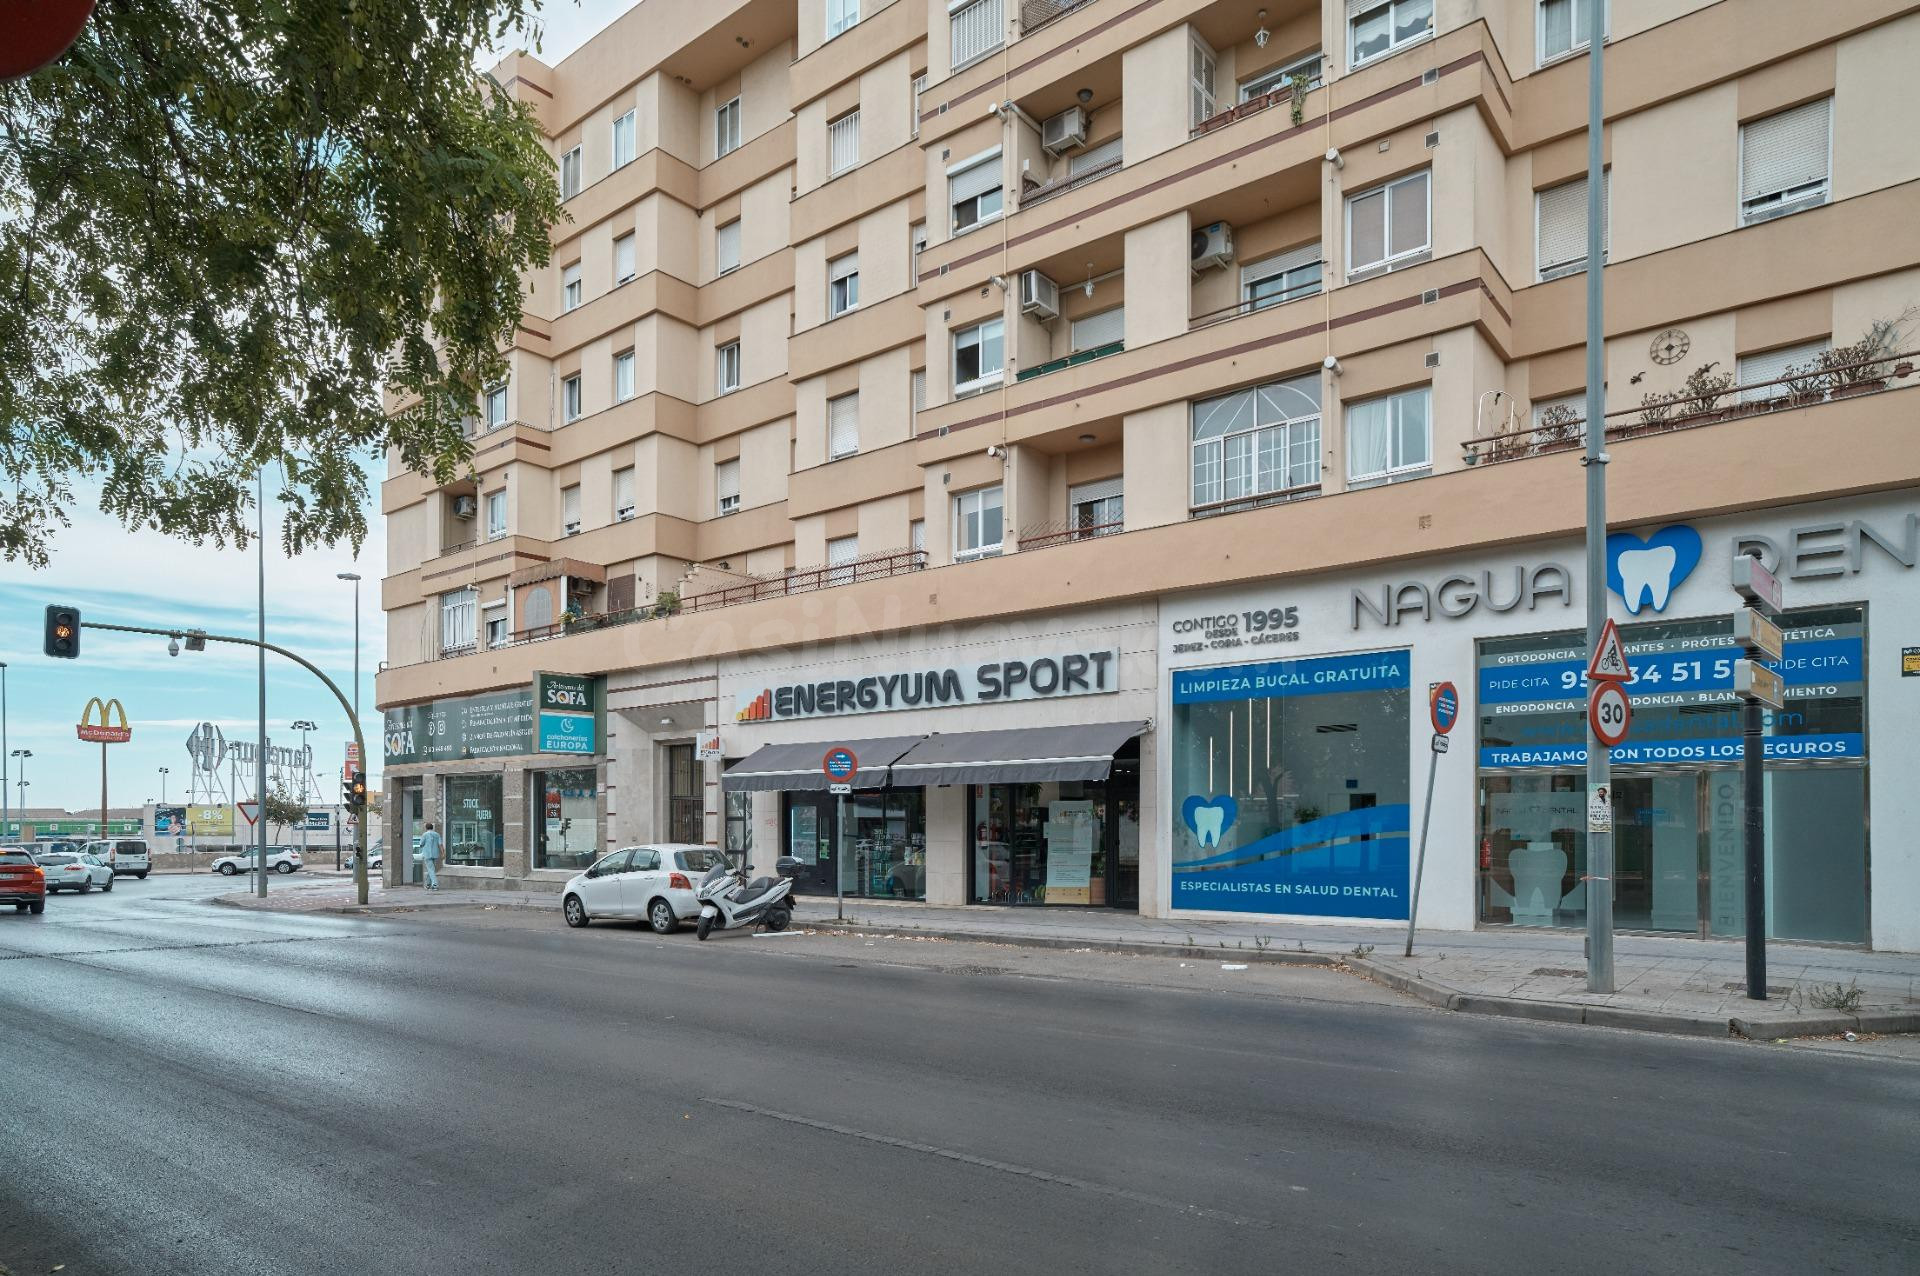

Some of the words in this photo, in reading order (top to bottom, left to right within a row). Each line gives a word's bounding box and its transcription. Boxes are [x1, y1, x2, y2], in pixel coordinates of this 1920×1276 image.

[1350, 562, 1571, 630] NAGUA
[1172, 613, 1239, 634] CONTIGO
[1242, 605, 1299, 633] 1995
[1172, 641, 1204, 654] JEREZ
[1210, 638, 1243, 649] CORIA
[1250, 631, 1300, 645] CÁCERES
[1204, 627, 1238, 640] DESDE
[1498, 651, 1576, 664] ORTODONCIA
[1623, 642, 1664, 653] ANTES
[1682, 636, 1735, 649] PRÓTES
[1783, 627, 1836, 641] TÉTICA
[774, 668, 966, 717] ENERGYUM
[976, 650, 1112, 701] SPORT
[1180, 678, 1251, 695] LIMPIEZA
[1255, 673, 1310, 688] BUCAL
[1314, 664, 1400, 684] GRATUITA
[1489, 680, 1518, 689] PIDE
[1521, 677, 1550, 688] CITA
[1561, 669, 1588, 690] 95
[1624, 664, 1662, 685] 34
[1671, 660, 1701, 682] 51
[1713, 659, 1735, 680] 5
[1769, 658, 1807, 671] PIDE
[1811, 655, 1849, 668] CITA
[547, 689, 587, 706] SOFA
[1496, 702, 1575, 714] ENDODONCIA
[1629, 694, 1684, 706] DONCIA
[1601, 702, 1623, 725] 30
[384, 731, 416, 757] SOFA
[546, 740, 588, 750] EUROPA
[1491, 750, 1588, 764] TRABAJAMO
[1609, 748, 1639, 760] ON
[1643, 746, 1705, 760] TODOS
[1710, 744, 1745, 757] LOS
[1764, 741, 1846, 755] EGUROS
[1717, 783, 1736, 928] BIENVENIDO
[1180, 881, 1271, 893] ESPECIALISTAS
[1275, 883, 1292, 894] EN
[1295, 885, 1339, 895] SALUD
[1343, 886, 1399, 898] DENTAL
